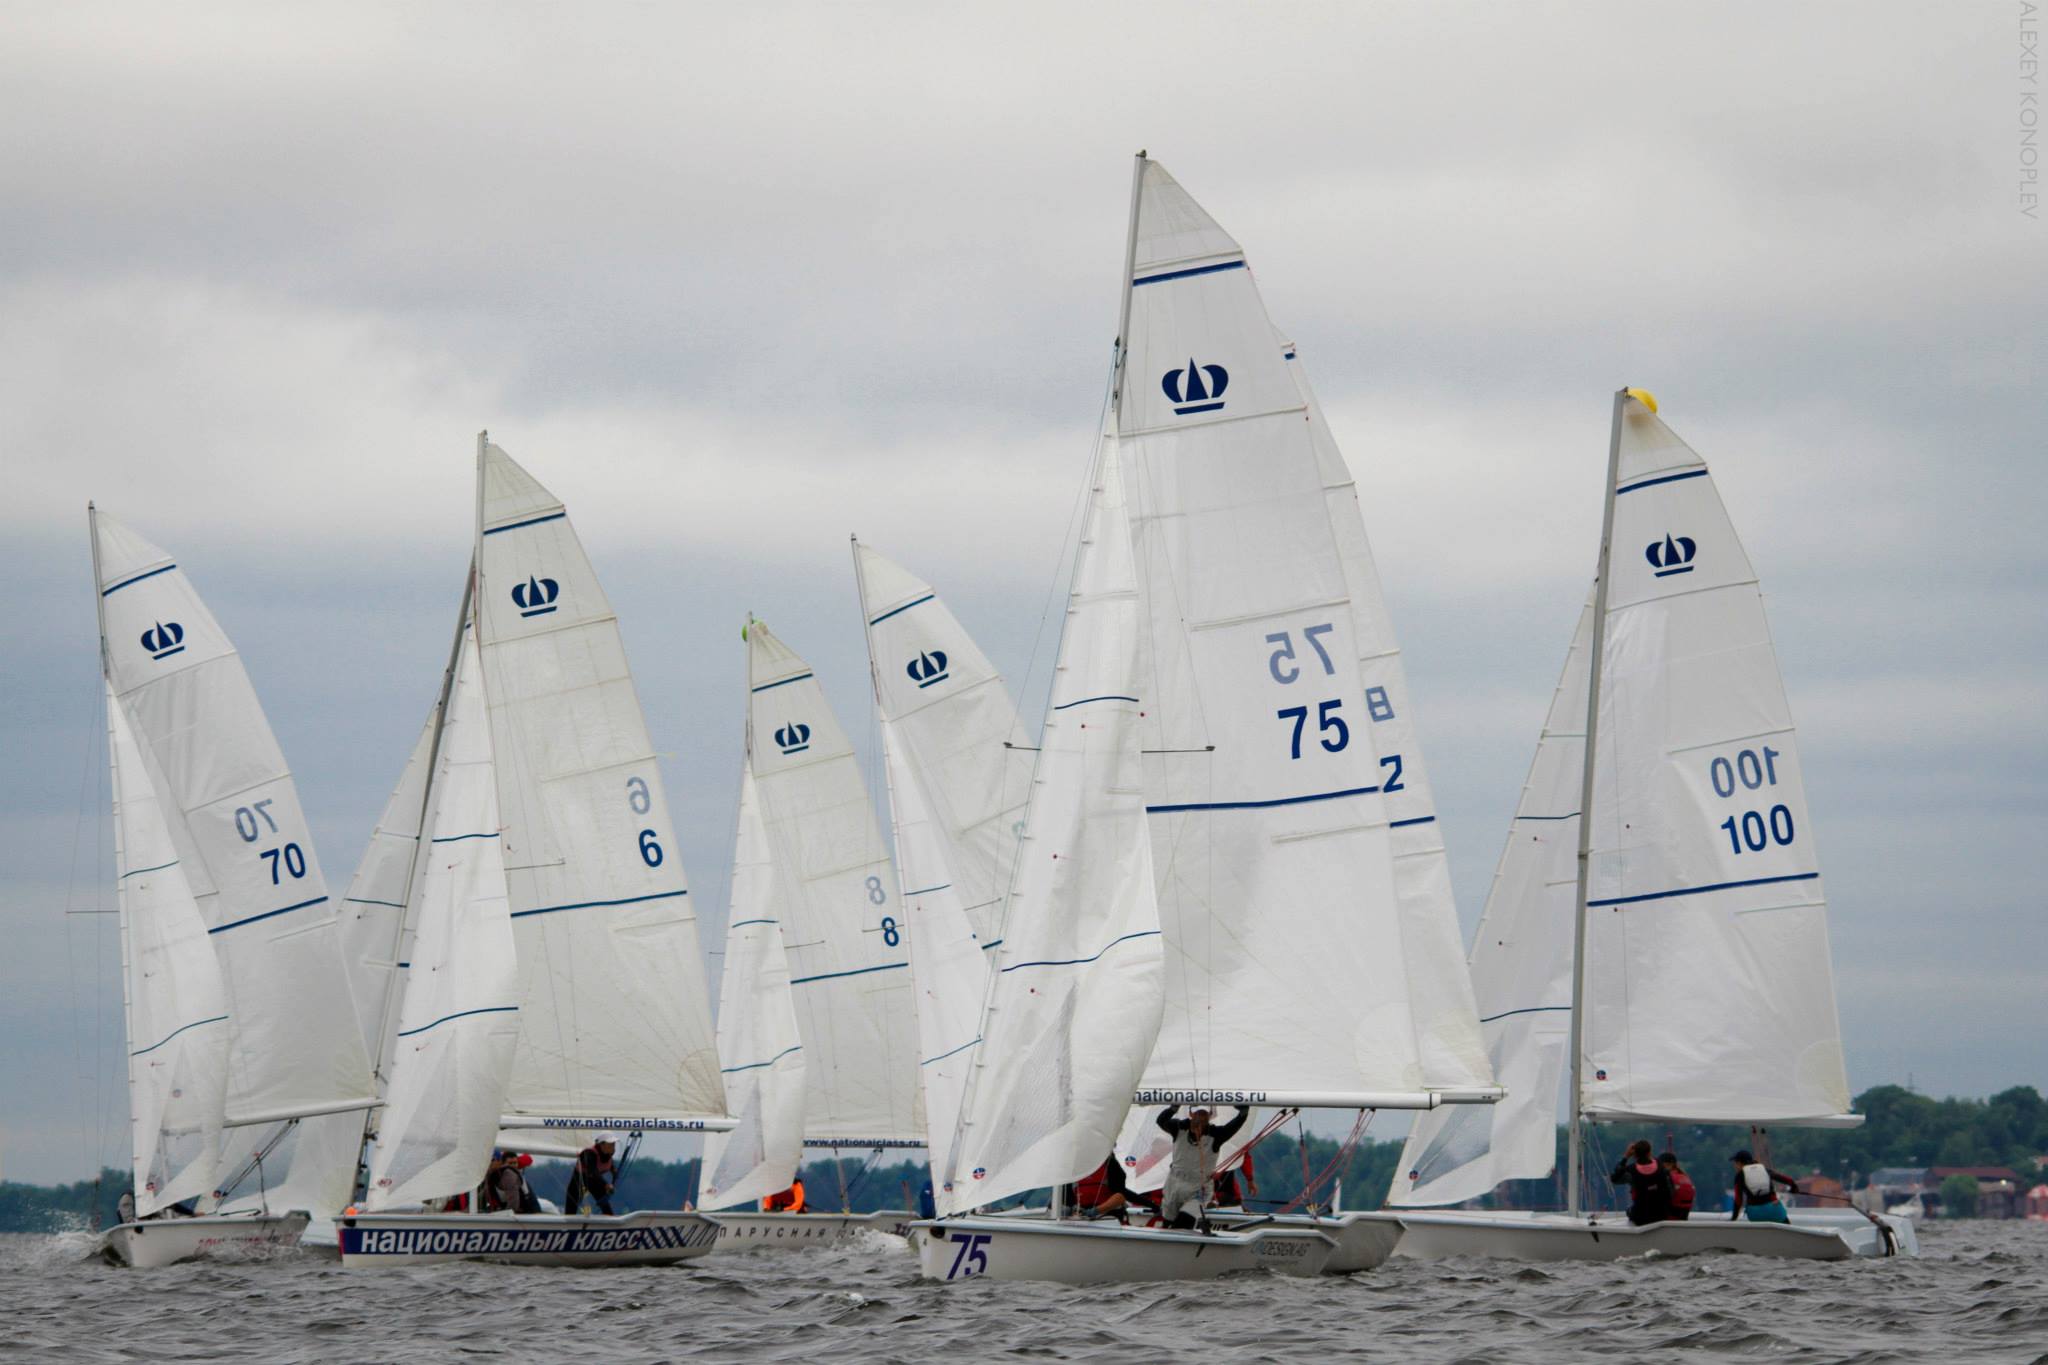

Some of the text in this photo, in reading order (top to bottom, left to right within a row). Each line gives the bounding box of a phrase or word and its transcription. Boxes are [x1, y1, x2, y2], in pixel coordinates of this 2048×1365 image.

[1277, 699, 1349, 759] 75
[638, 829, 663, 867] 6
[1721, 804, 1794, 854] 100
[260, 843, 306, 885] 70
[881, 917, 899, 947] 8
[543, 1117, 704, 1129] www.nationalclass.ru
[802, 1138, 920, 1148] www.nationalclass.ru
[719, 1223, 826, 1240] ПАРУСНАЯ
[947, 1233, 992, 1280] 75
